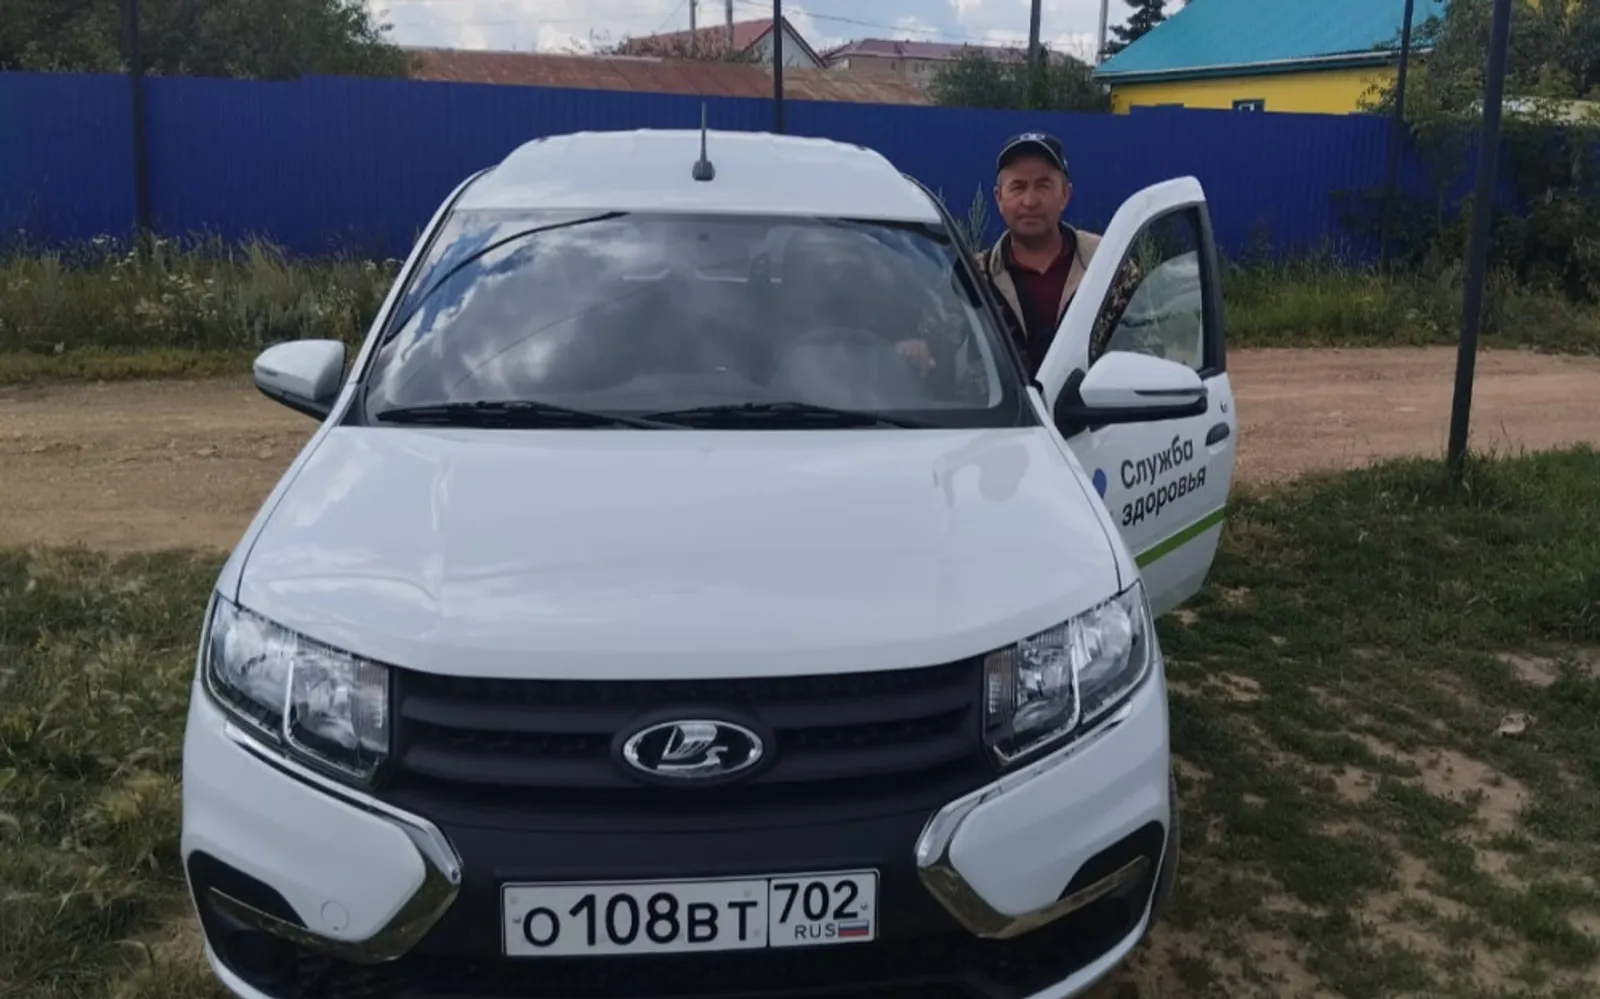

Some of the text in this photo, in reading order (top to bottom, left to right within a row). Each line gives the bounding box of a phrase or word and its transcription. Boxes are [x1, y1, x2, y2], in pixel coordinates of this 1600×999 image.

[1120, 433, 1194, 489] Служба
[1122, 466, 1207, 526] здоровья
[773, 880, 860, 923] 702
[794, 923, 837, 940] RUS
